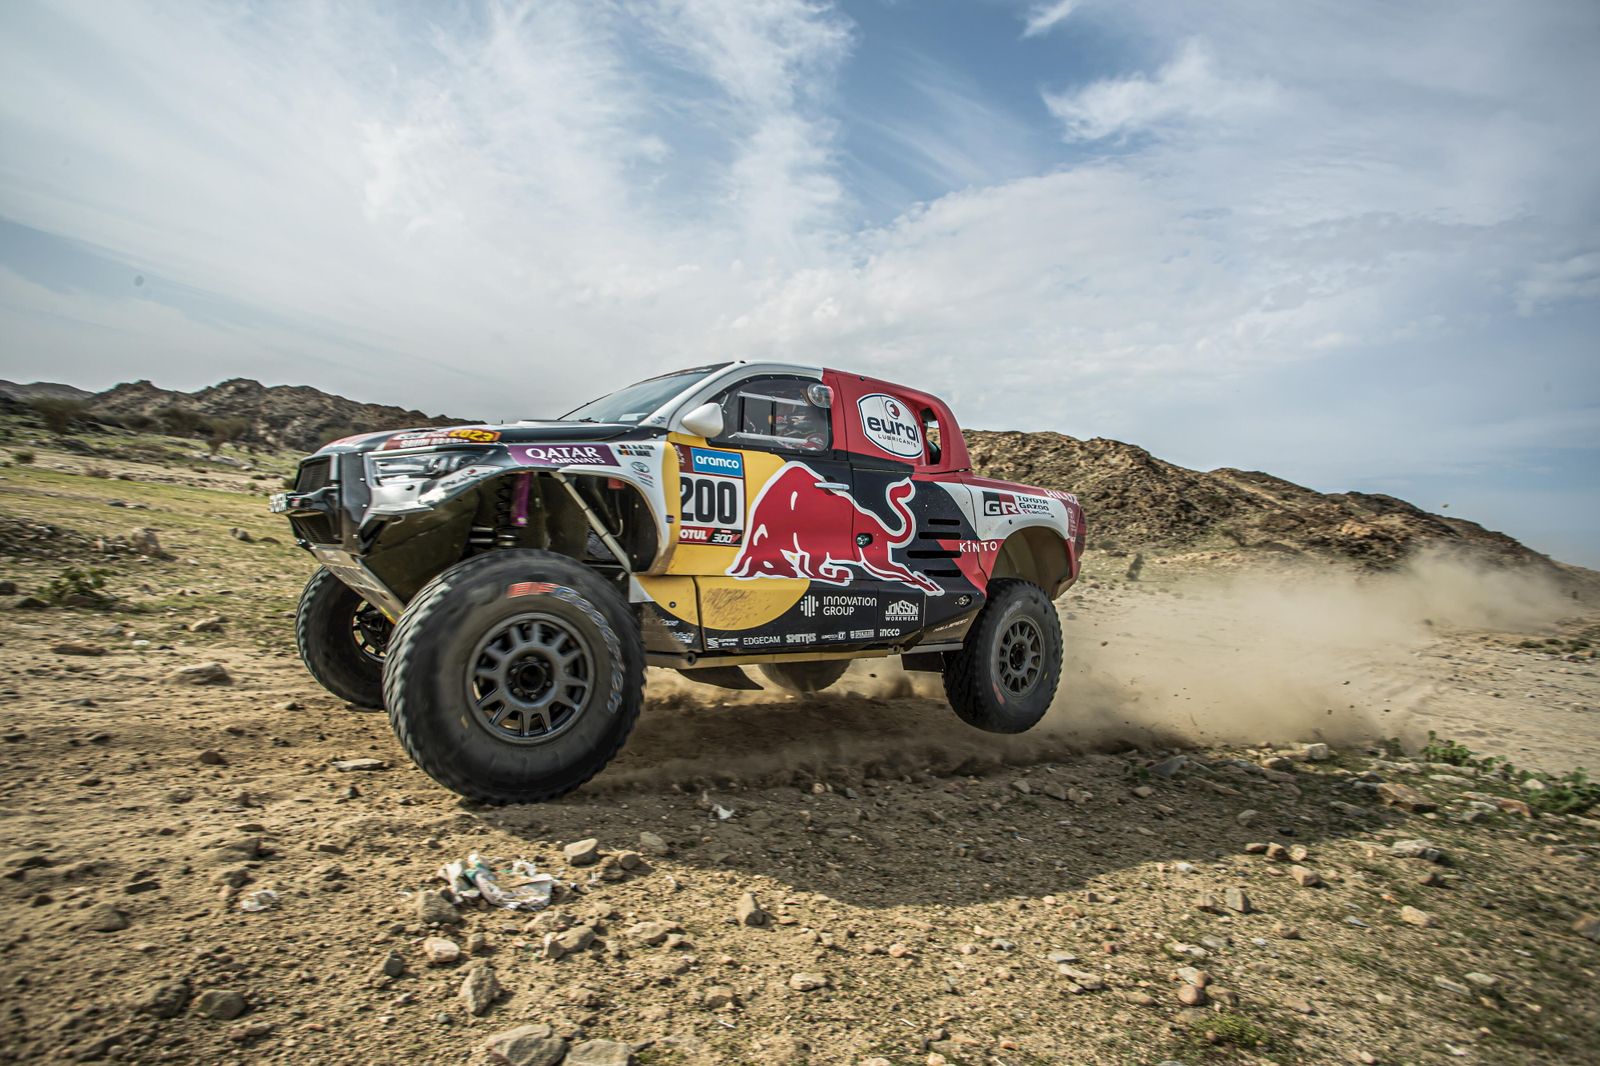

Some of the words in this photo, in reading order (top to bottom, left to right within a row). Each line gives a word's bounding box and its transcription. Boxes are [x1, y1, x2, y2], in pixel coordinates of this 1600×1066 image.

[447, 429, 494, 441] 2023
[867, 417, 919, 443] eurol
[878, 434, 917, 448] LUBRICANTS
[525, 447, 601, 460] QATAR
[695, 455, 740, 469] aramco
[680, 476, 737, 525] 200
[1017, 495, 1049, 505] TOYOTA
[985, 500, 1020, 516] GR
[1019, 502, 1050, 512] GAZOO
[680, 529, 707, 540] OTUL
[823, 606, 855, 616] GROUP
[885, 600, 919, 615] JONSSON
[743, 636, 781, 645] EDGECAM
